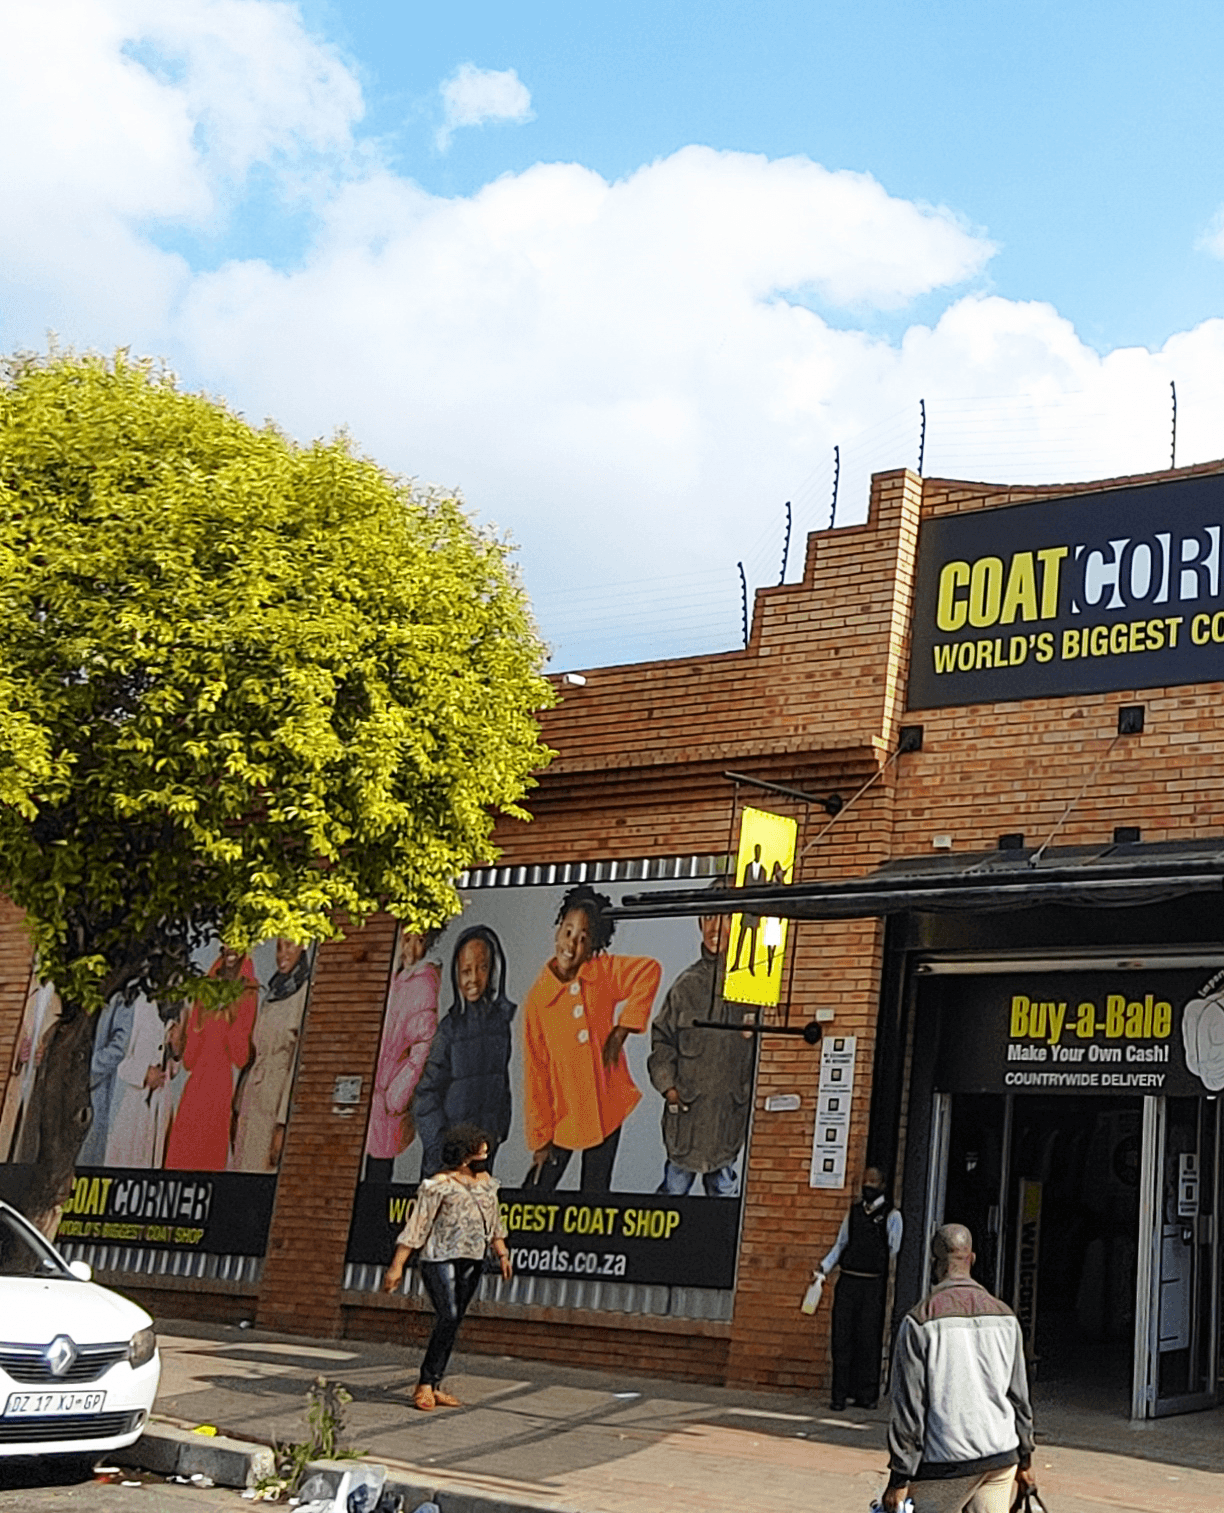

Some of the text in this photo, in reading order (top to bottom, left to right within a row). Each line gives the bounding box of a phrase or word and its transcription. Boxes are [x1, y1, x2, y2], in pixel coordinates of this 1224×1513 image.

[936, 546, 1068, 631] COAT
[933, 632, 1054, 675] WORLD'S
[1062, 617, 1183, 660] BIGGEST
[1010, 994, 1172, 1044] Buy-a-Bale
[1007, 1044, 1169, 1062] Make Your Own Cash!
[1005, 1072, 1166, 1087] COUNTRYWIDE DELIVERY
[110, 1178, 213, 1221] CORNER
[563, 1206, 619, 1235] COAT
[622, 1208, 681, 1239] SHOP
[510, 1244, 627, 1276] rcoats.co.za
